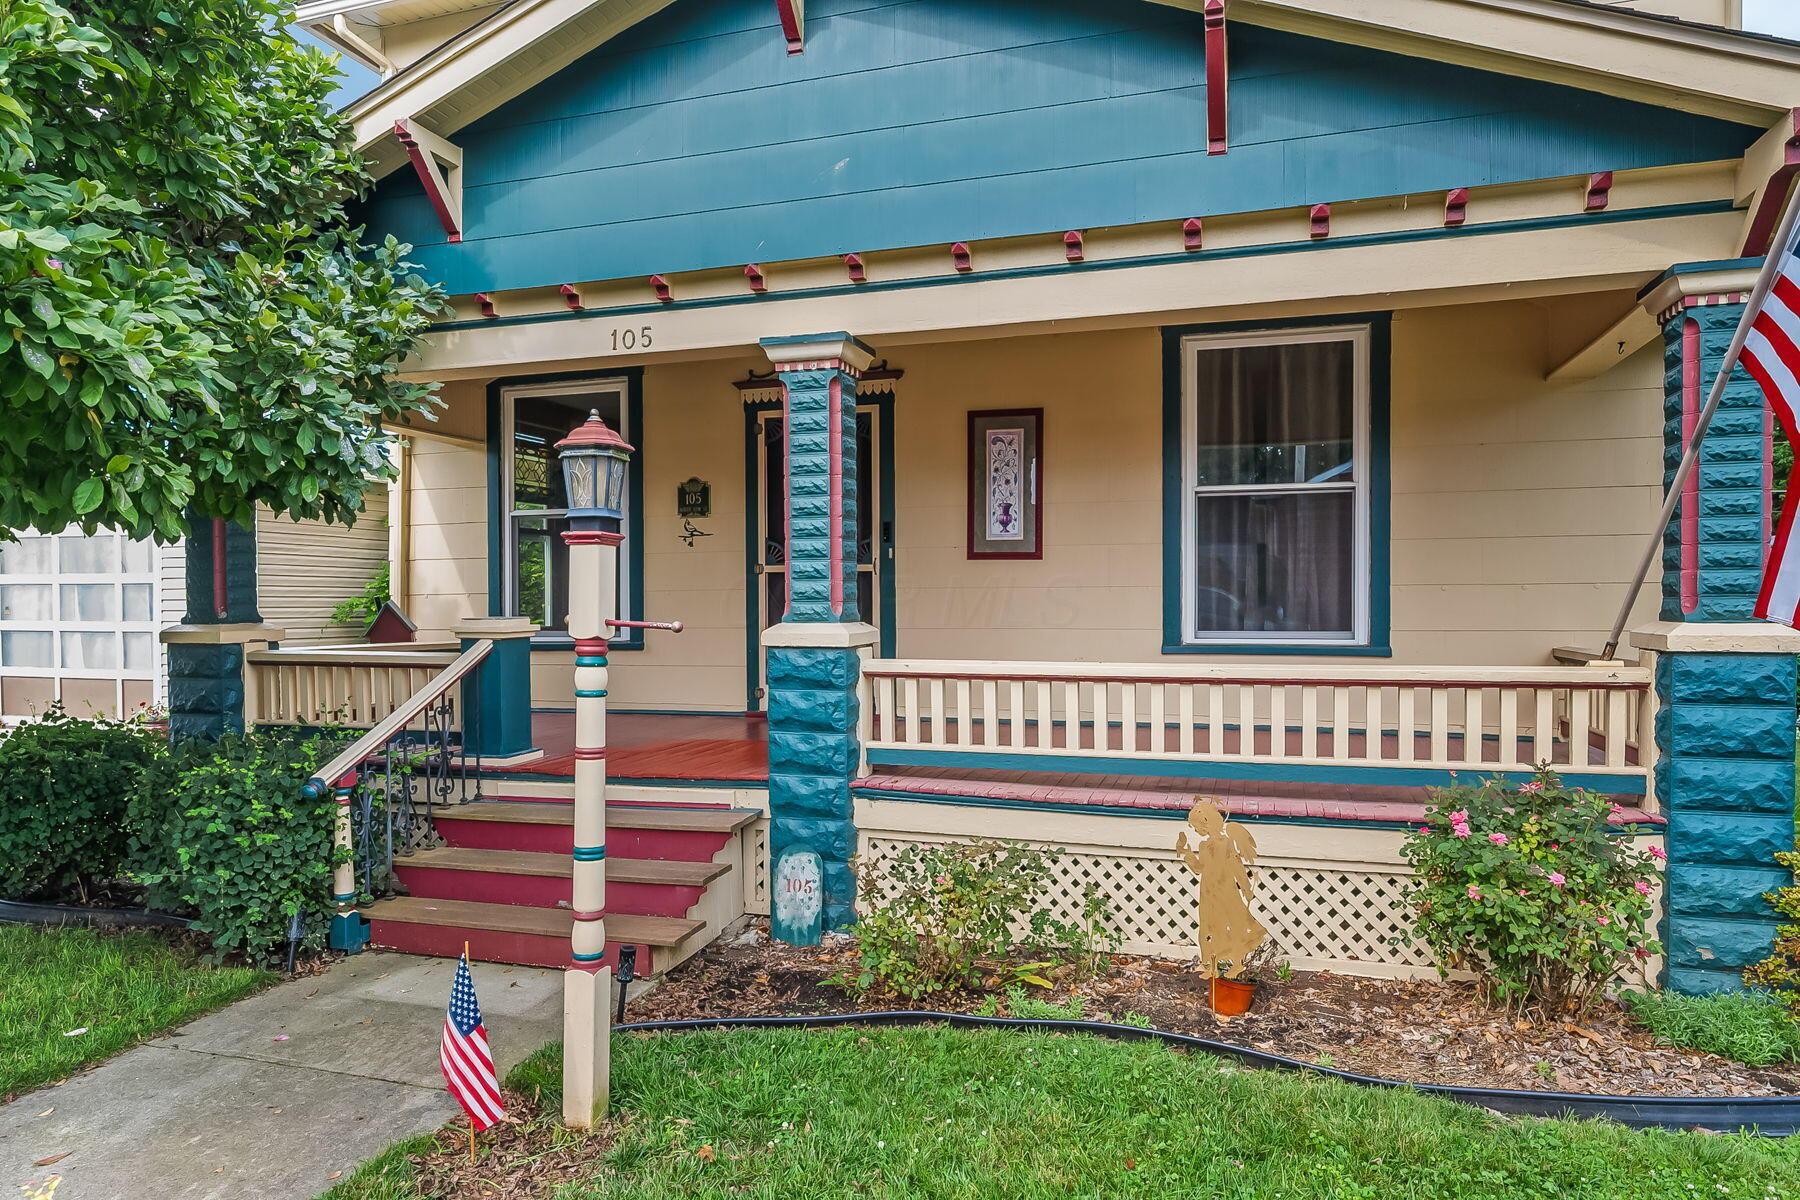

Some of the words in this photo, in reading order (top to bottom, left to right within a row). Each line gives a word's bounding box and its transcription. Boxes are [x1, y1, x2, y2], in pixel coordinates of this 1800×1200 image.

[610, 325, 653, 351] 105
[685, 492, 702, 505] 105
[785, 879, 813, 894] 105
